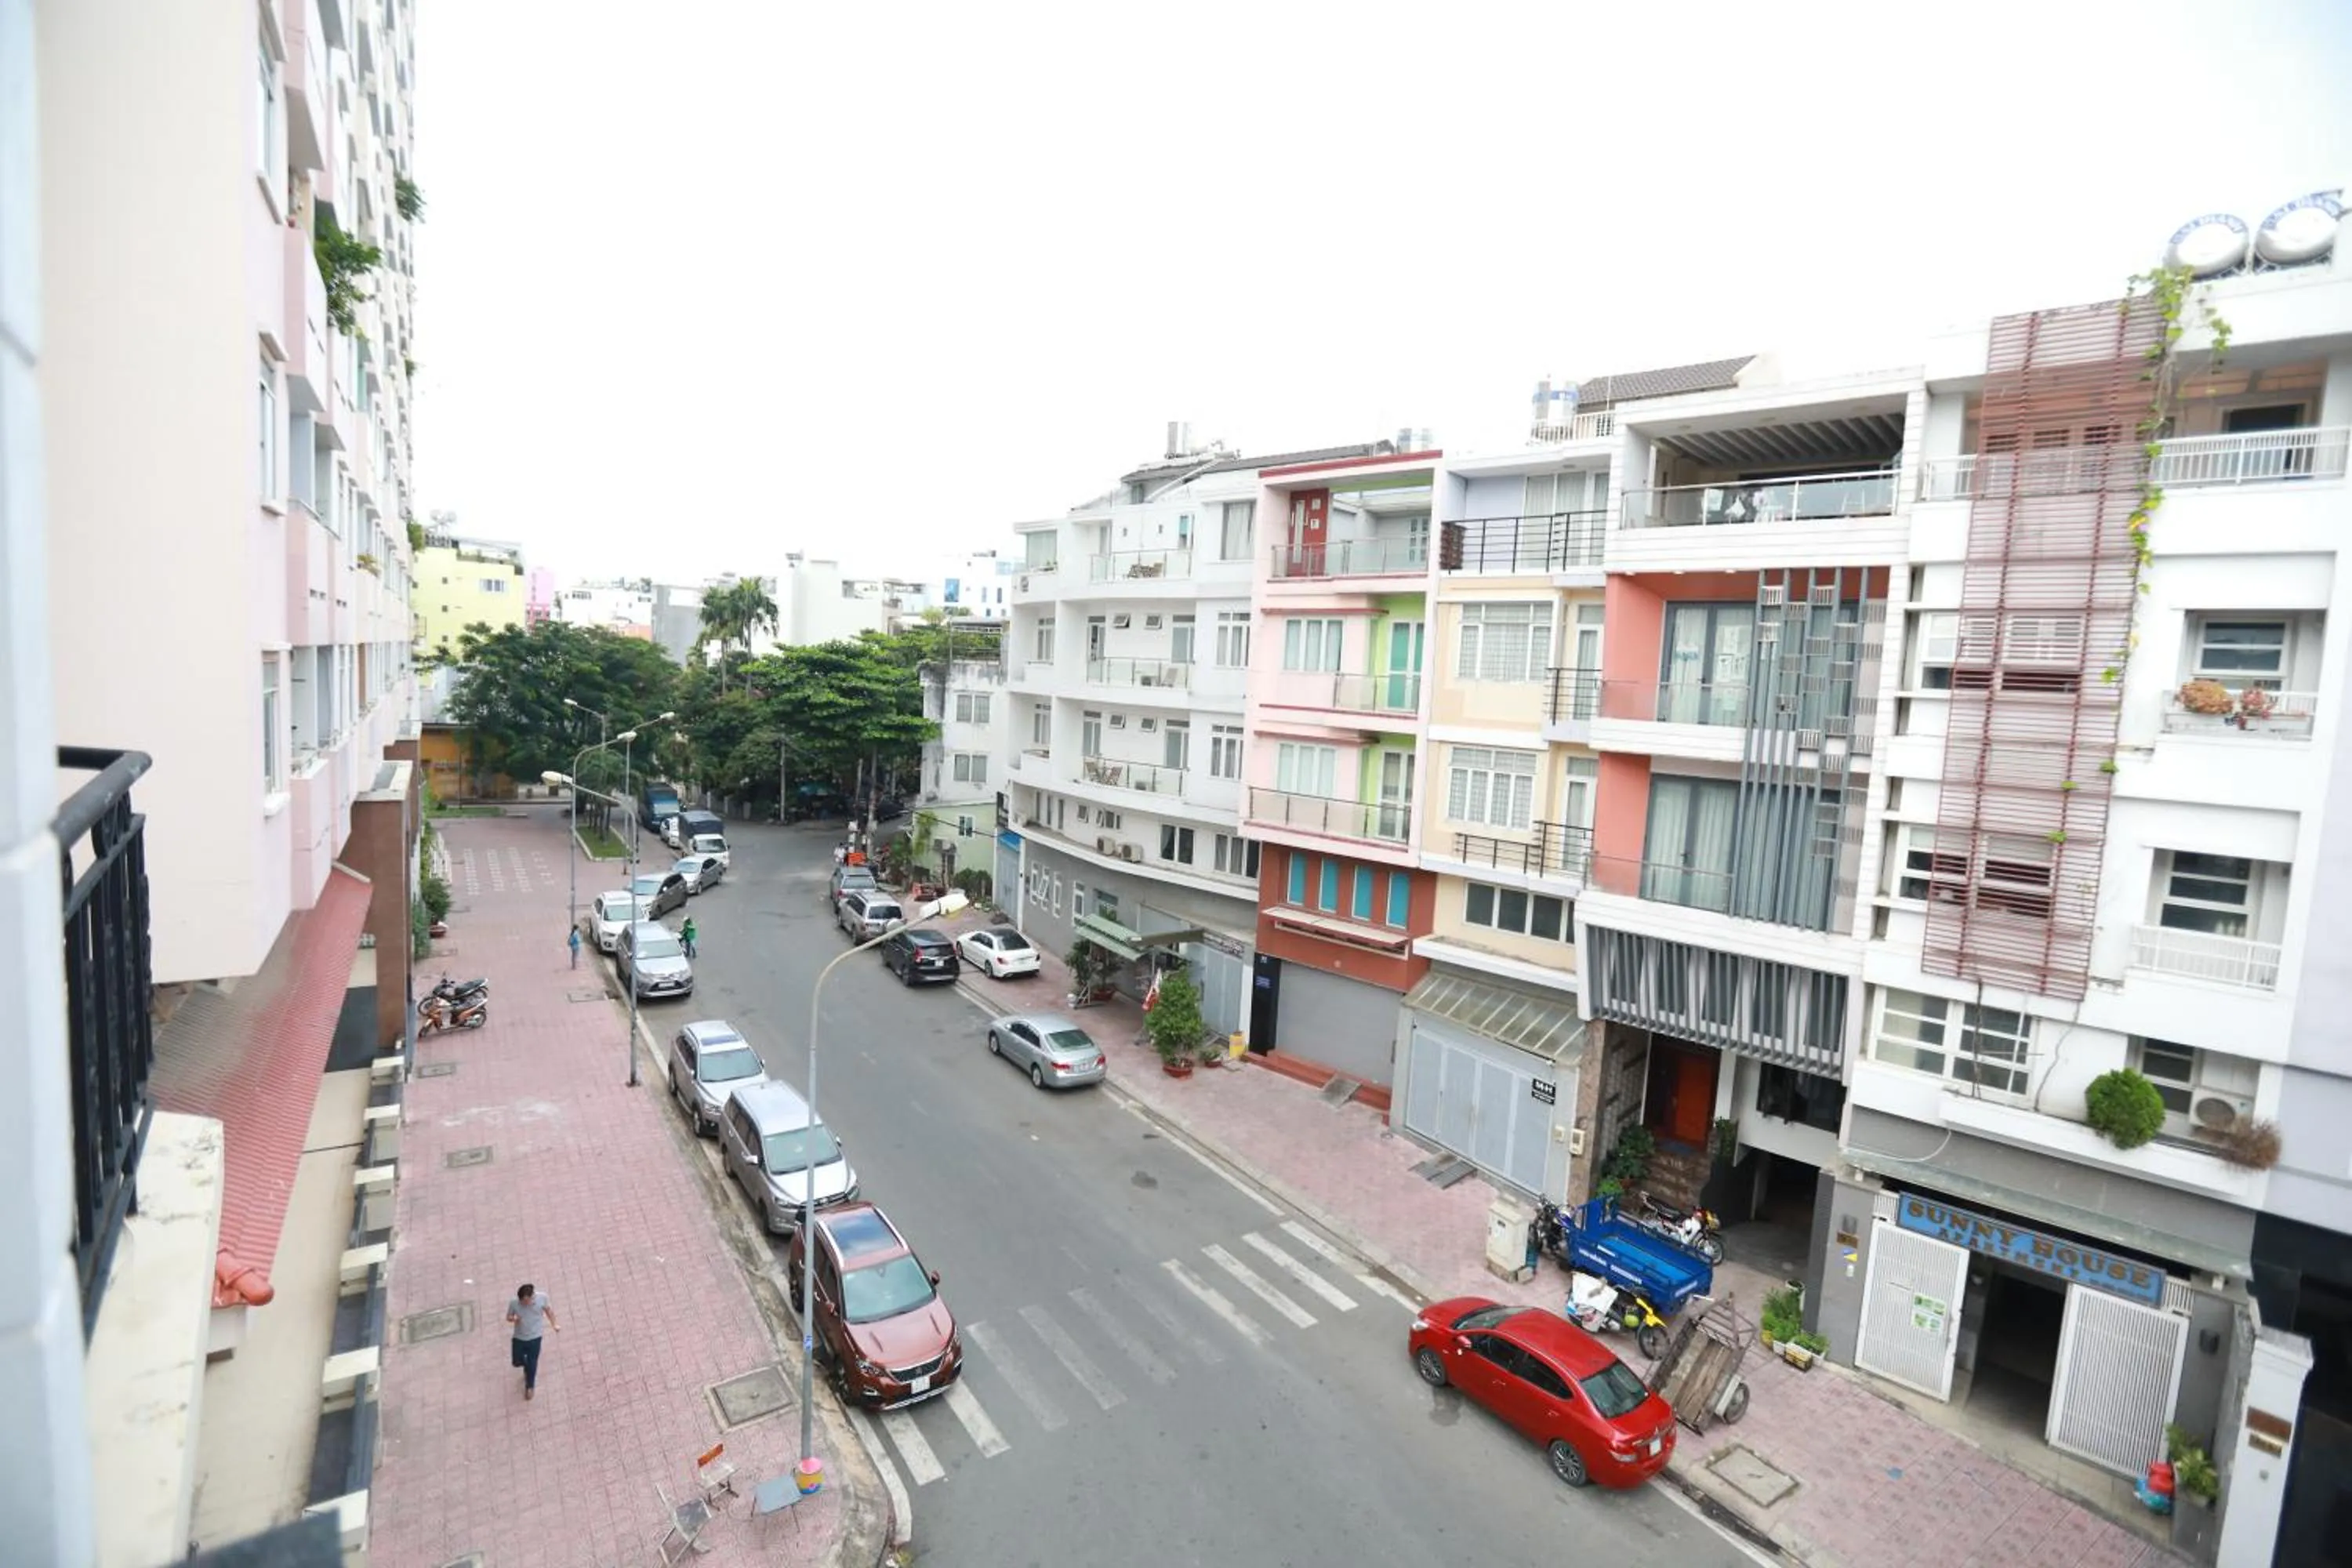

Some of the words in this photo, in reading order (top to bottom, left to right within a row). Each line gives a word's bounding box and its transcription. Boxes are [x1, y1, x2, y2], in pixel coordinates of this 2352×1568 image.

[1907, 1200, 2016, 1246] SUNNY
[2032, 1236, 2151, 1290] HOUSE
[1939, 1227, 2080, 1278] APARTMENT
